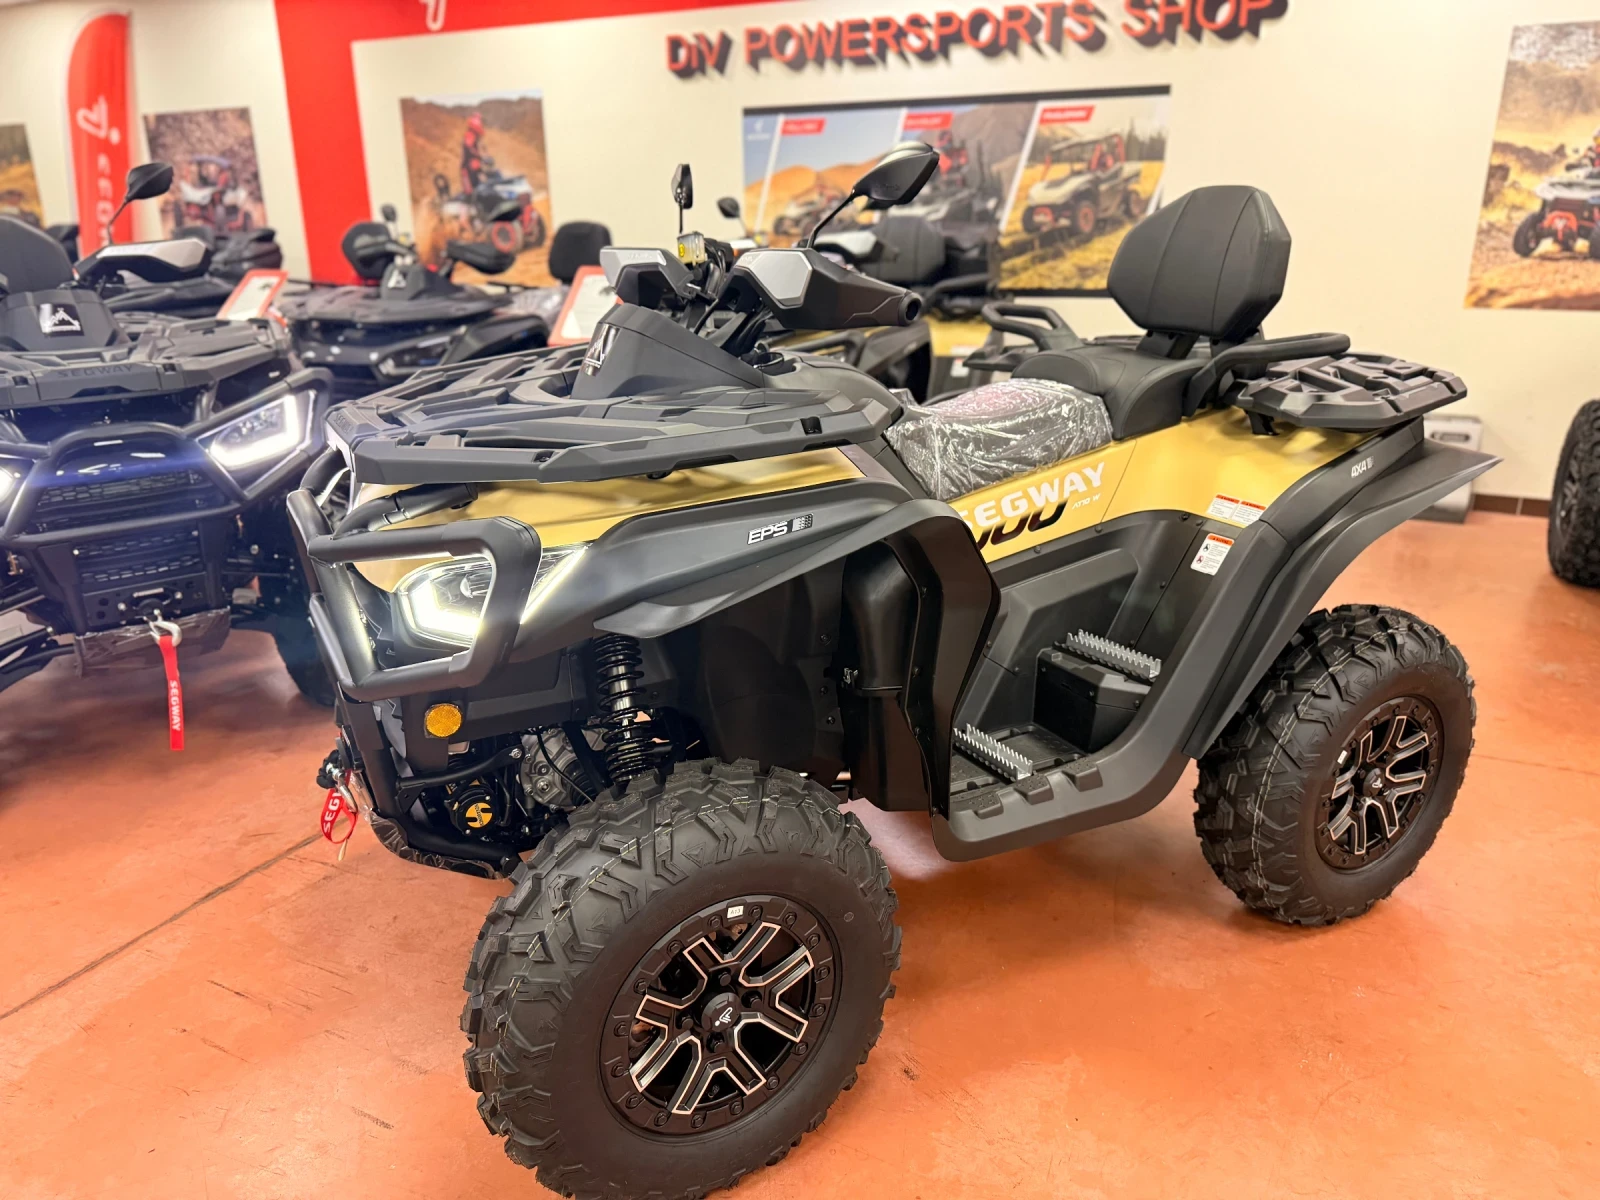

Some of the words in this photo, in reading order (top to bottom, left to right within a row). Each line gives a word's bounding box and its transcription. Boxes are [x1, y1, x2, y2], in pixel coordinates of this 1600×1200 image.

[745, 0, 1099, 68] POWERSPORTS
[1121, 0, 1278, 41] SHOP
[56, 364, 134, 378] SEGWAY
[747, 521, 788, 545] EPS
[169, 680, 182, 732] SEGWAY
